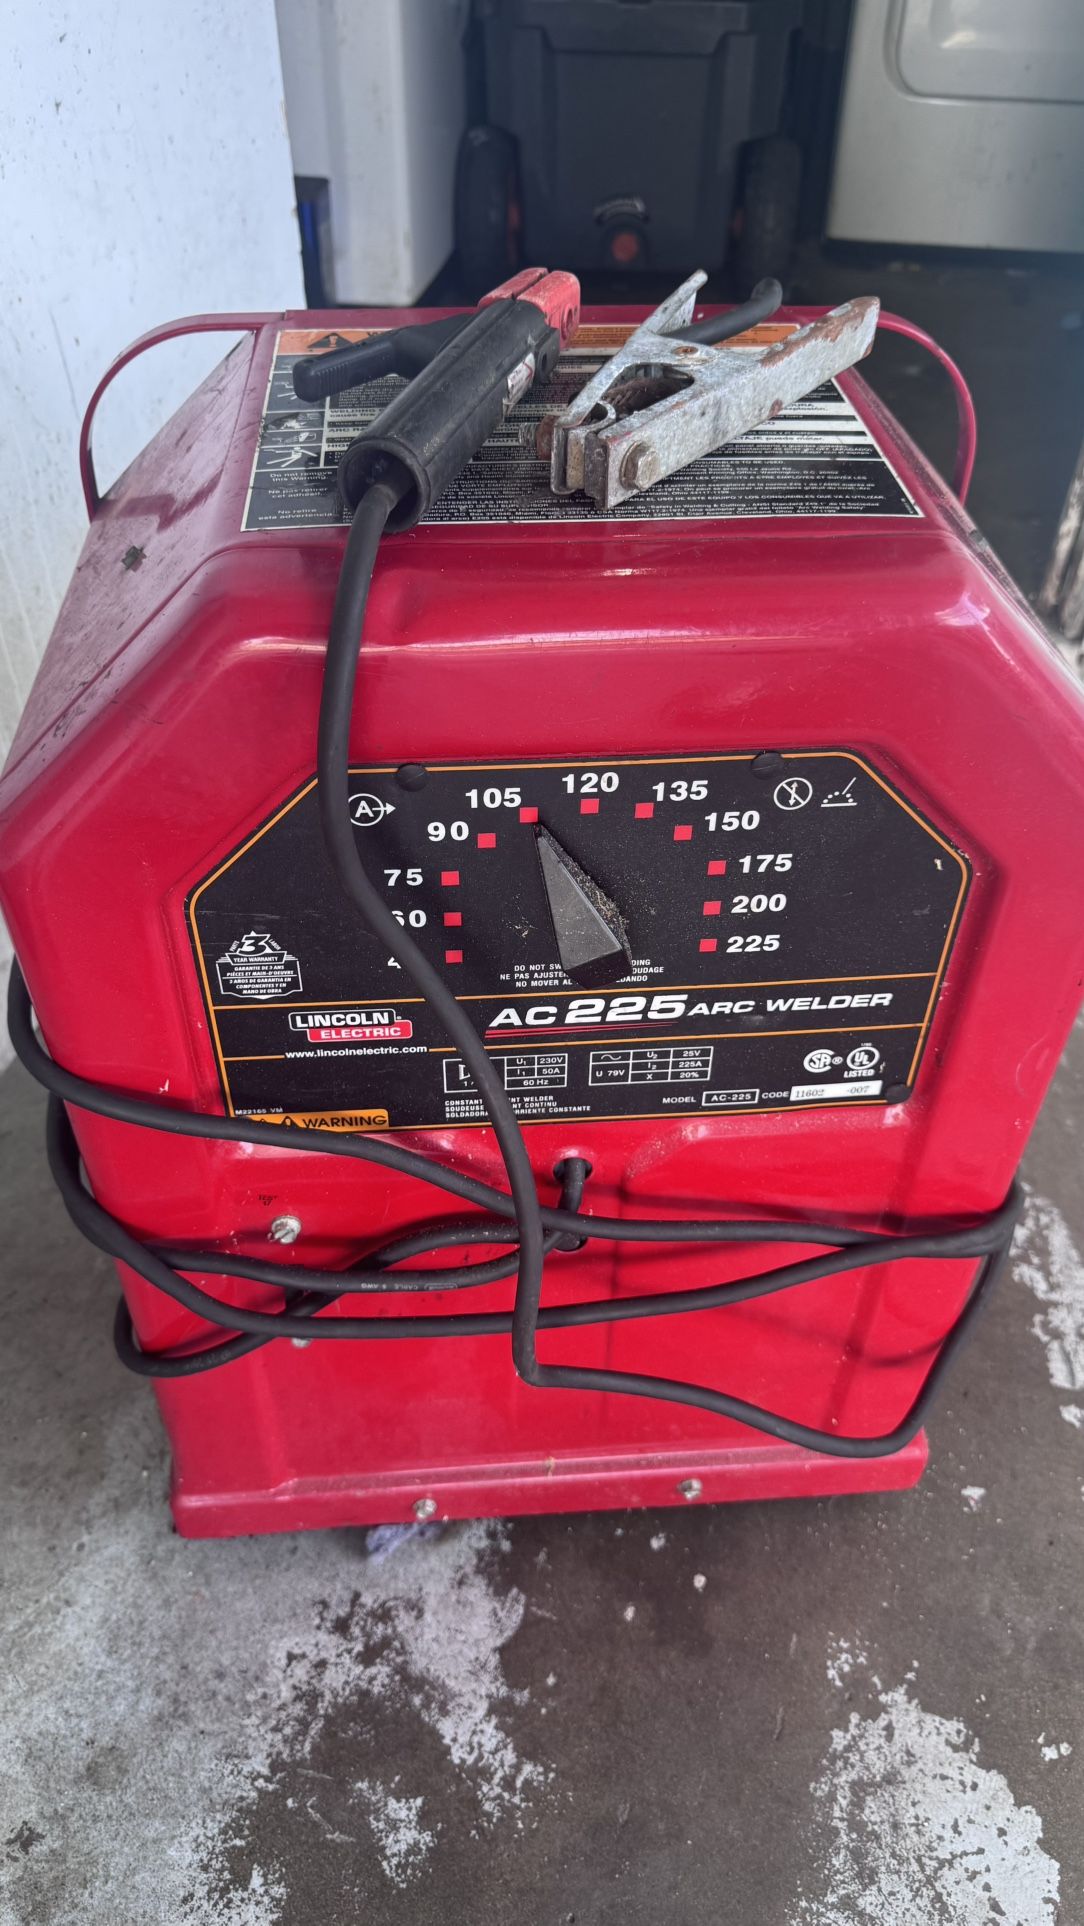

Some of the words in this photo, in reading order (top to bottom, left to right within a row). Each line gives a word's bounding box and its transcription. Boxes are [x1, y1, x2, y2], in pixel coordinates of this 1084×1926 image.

[561, 771, 619, 794] 120
[465, 787, 522, 809] 105
[652, 780, 709, 802] 135
[704, 810, 760, 831] 150
[427, 821, 469, 842] 90
[738, 853, 793, 874] 175
[383, 868, 424, 887] 75
[730, 893, 787, 914] 200
[726, 934, 781, 953] 225
[632, 966, 665, 974] OUDAGE
[687, 1000, 756, 1016] ARC
[766, 993, 894, 1012] WELDER
[295, 1012, 389, 1028] LINCOLN
[320, 1027, 402, 1039] ELECTRIC
[285, 1046, 428, 1059] www.lincolnelectric.com
[539, 1056, 563, 1064] 230V
[607, 1069, 625, 1077] 79V
[680, 1071, 699, 1079] 20%
[843, 1069, 875, 1078] LISTED
[523, 1095, 554, 1103] WELDER
[662, 1096, 697, 1104] MODEL
[710, 1093, 752, 1102] AC-225
[762, 1090, 789, 1099] CODE
[524, 1101, 557, 1109] CONTINU
[302, 1115, 387, 1128] WARNING
